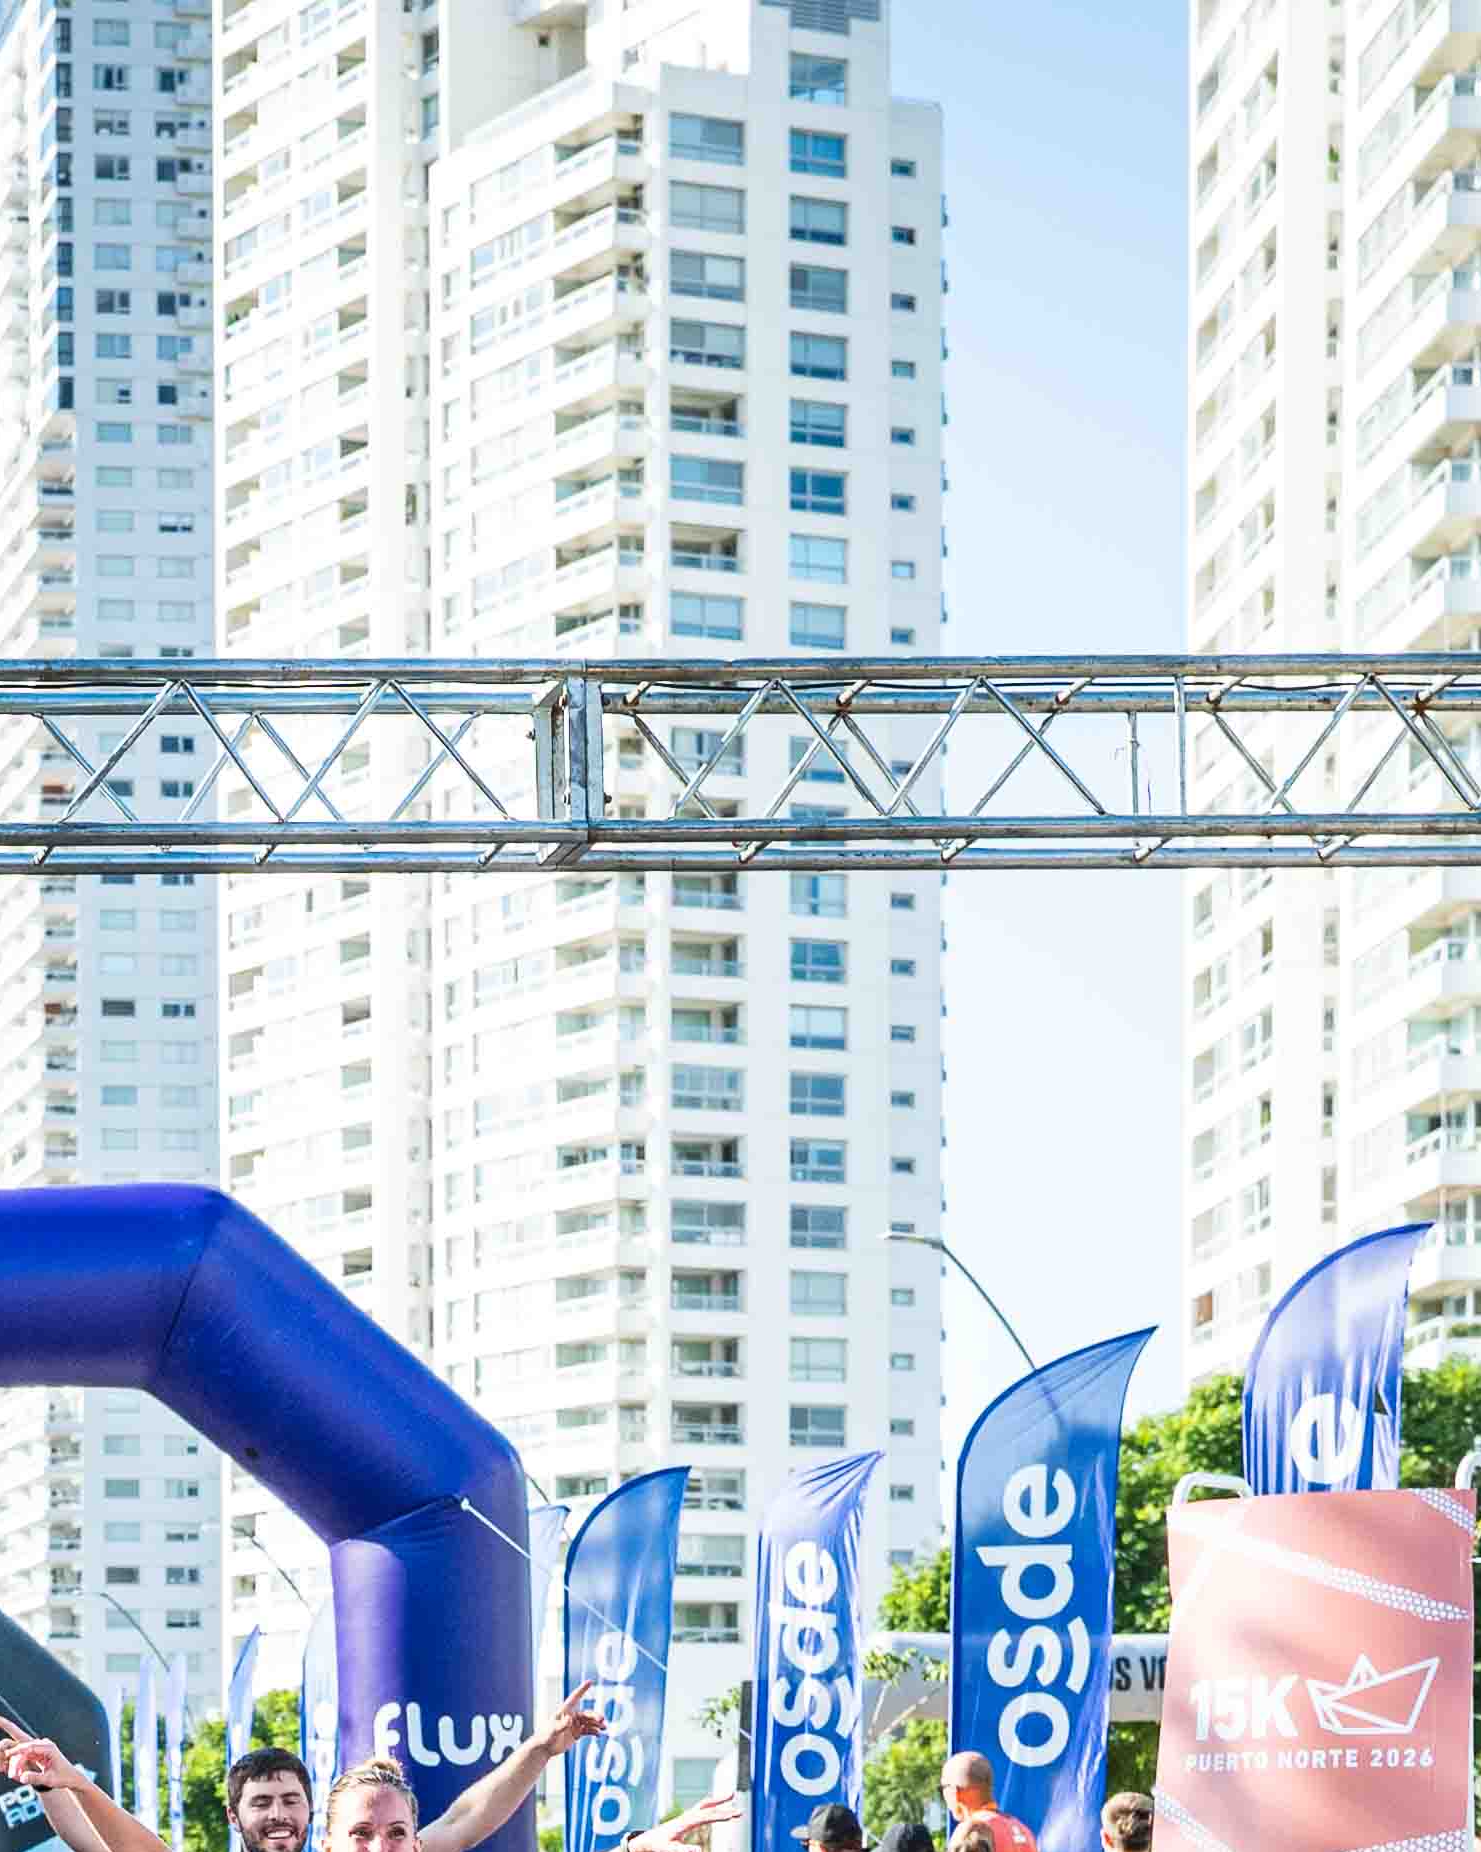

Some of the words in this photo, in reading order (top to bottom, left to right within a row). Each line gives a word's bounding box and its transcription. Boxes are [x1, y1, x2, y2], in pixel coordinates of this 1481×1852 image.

[768, 1540, 851, 1797] osde
[975, 1463, 1089, 1768] osde
[1188, 1672, 1300, 1745] 15K
[584, 1630, 642, 1836] osde
[1185, 1748, 1270, 1774] PUERTO
[1278, 1748, 1360, 1771] NORTE
[1369, 1746, 1435, 1770] 2026
